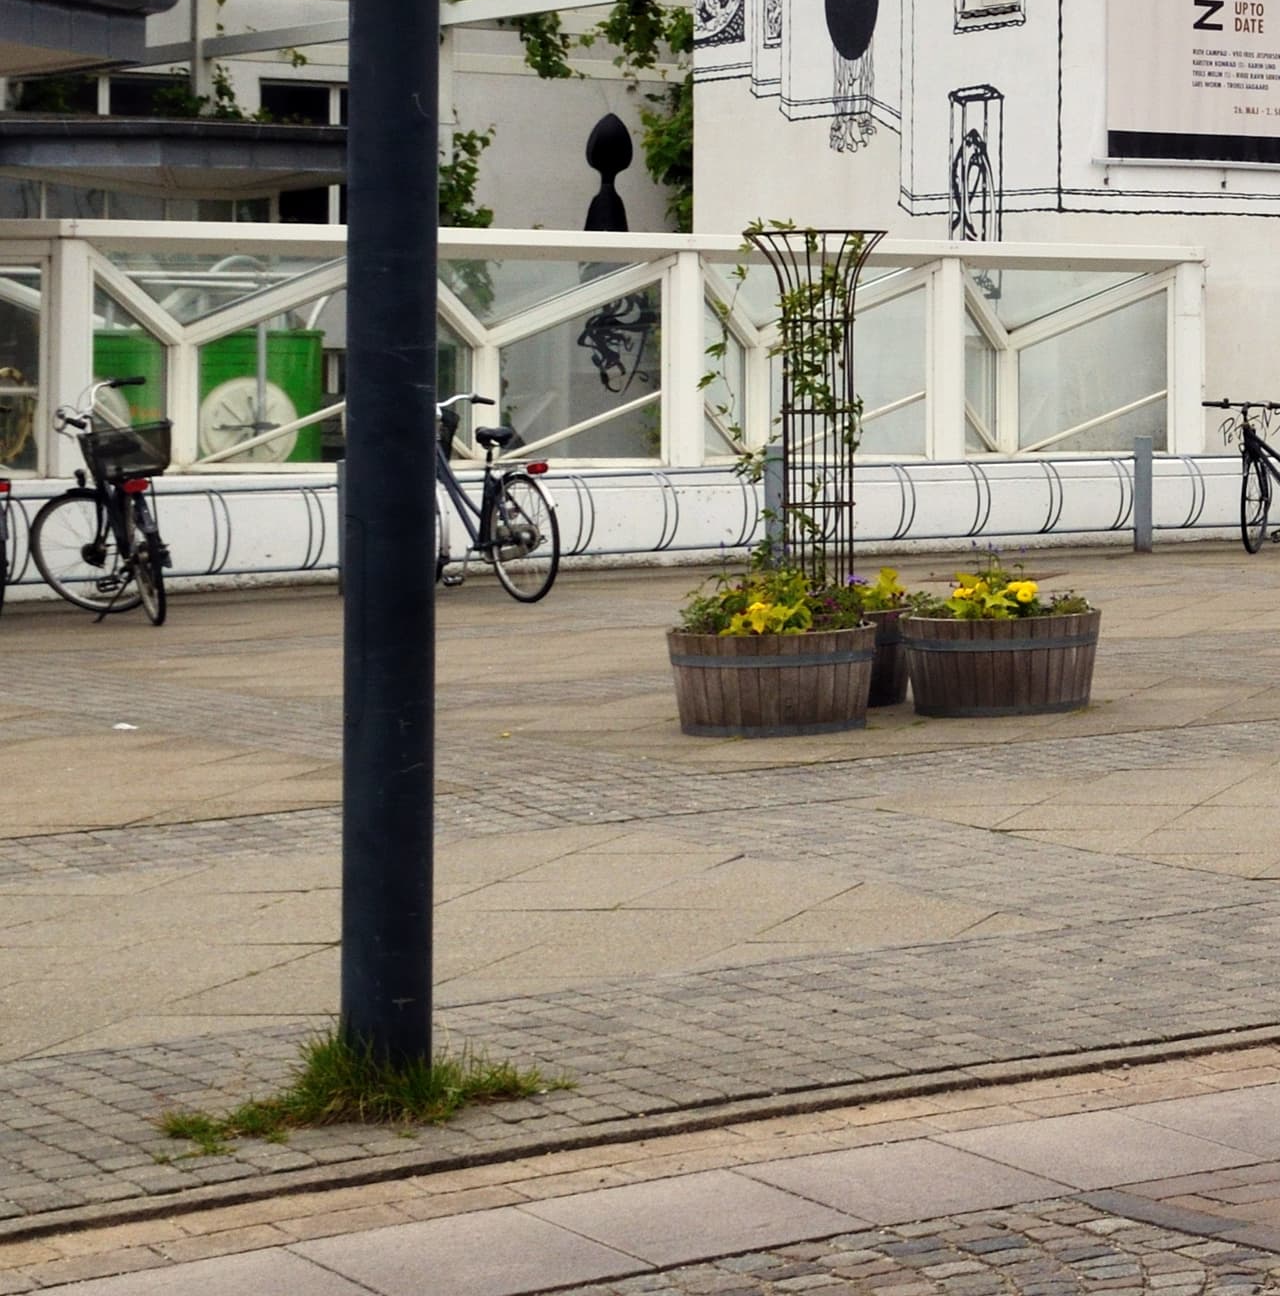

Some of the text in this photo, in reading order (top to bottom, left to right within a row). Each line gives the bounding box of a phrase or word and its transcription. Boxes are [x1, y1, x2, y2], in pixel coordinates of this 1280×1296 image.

[1234, 1, 1265, 17] UP TO
[1234, 17, 1265, 34] DATE
[1245, 106, 1260, 116] MAJ
